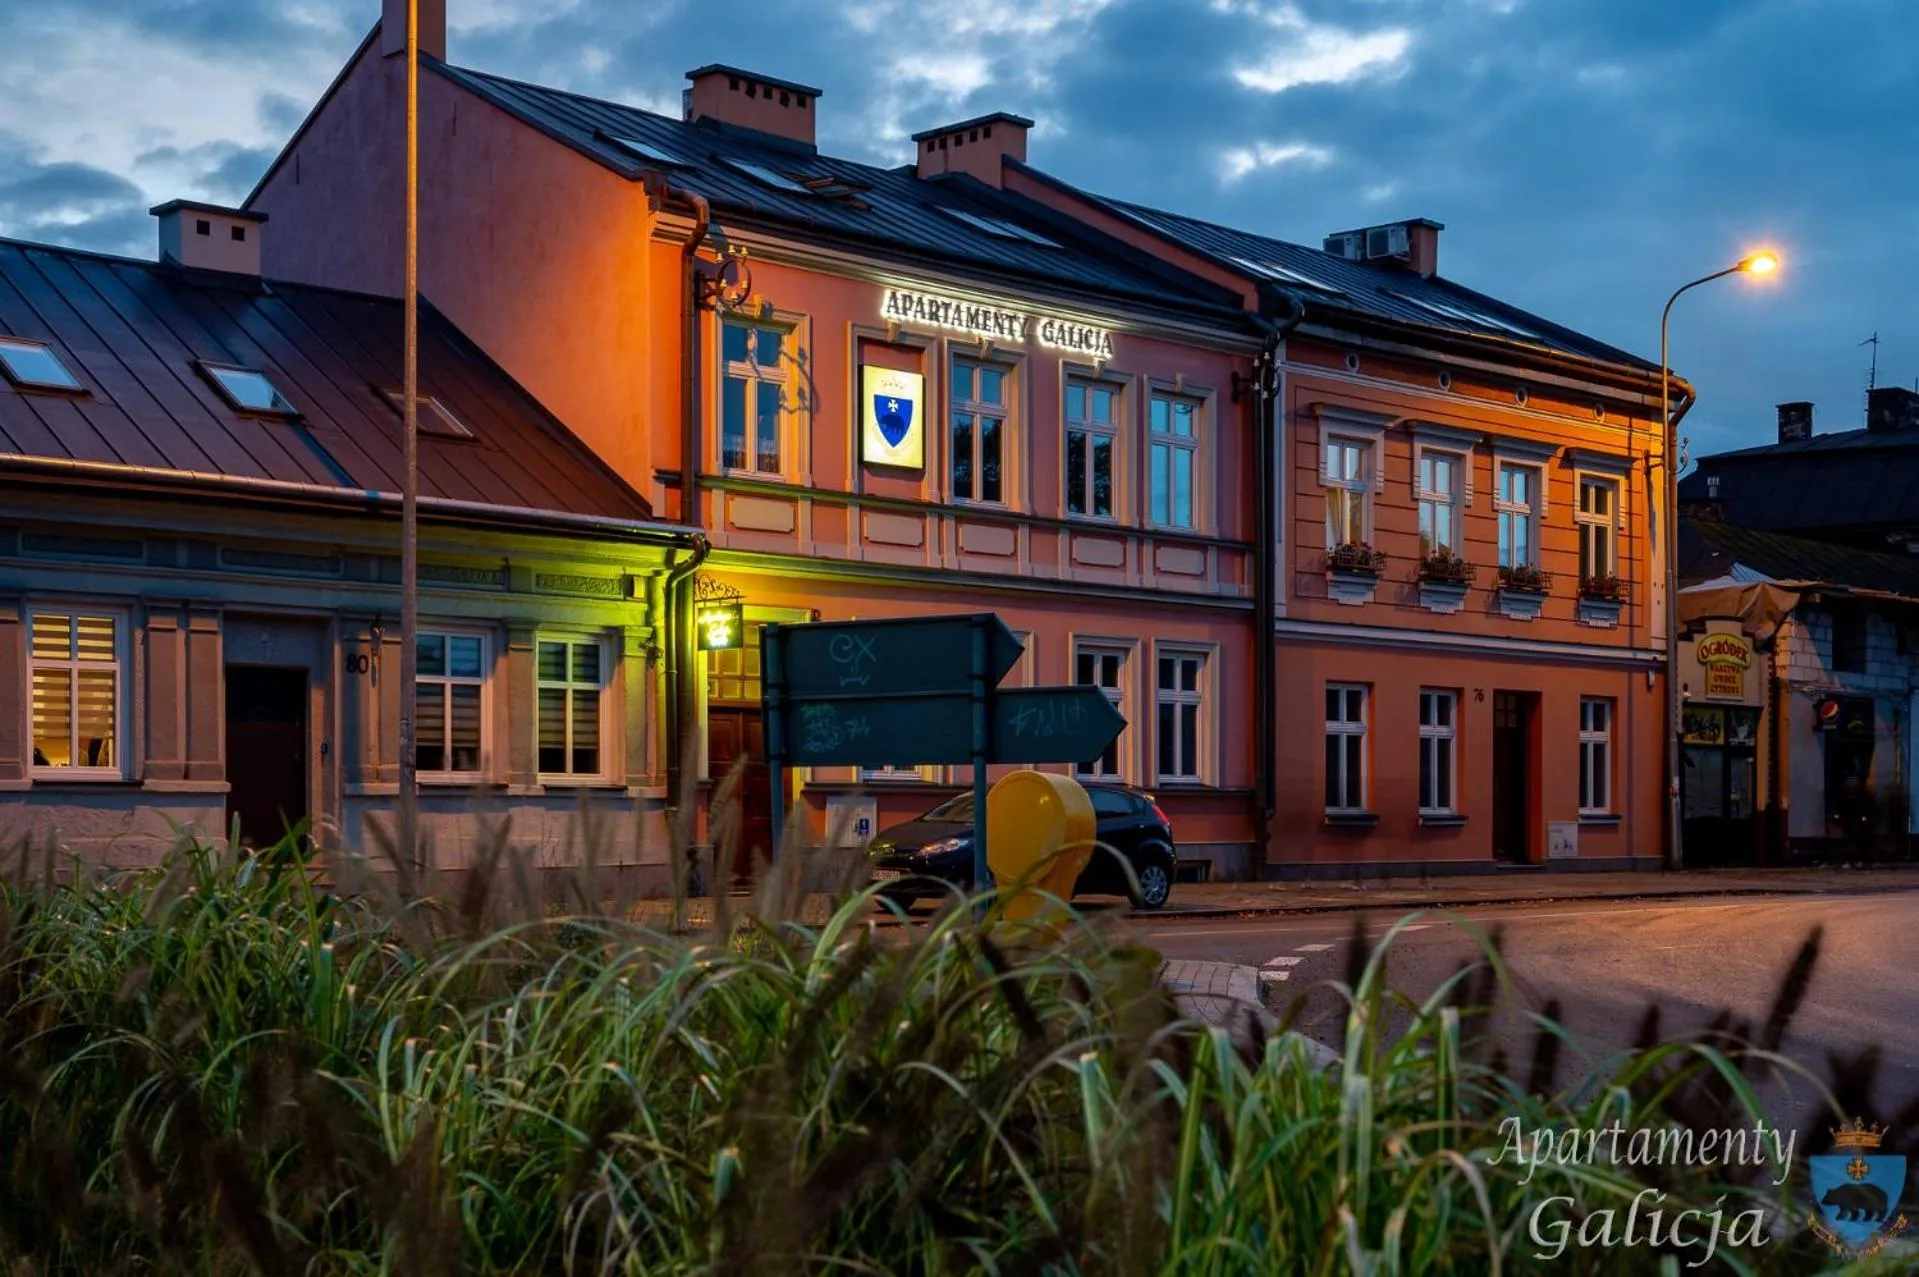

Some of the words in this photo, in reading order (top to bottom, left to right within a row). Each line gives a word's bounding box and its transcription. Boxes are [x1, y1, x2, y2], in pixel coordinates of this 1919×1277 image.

[885, 290, 1029, 341] APARTAMENTY
[1041, 318, 1114, 357] GALICJA
[345, 652, 370, 674] 80
